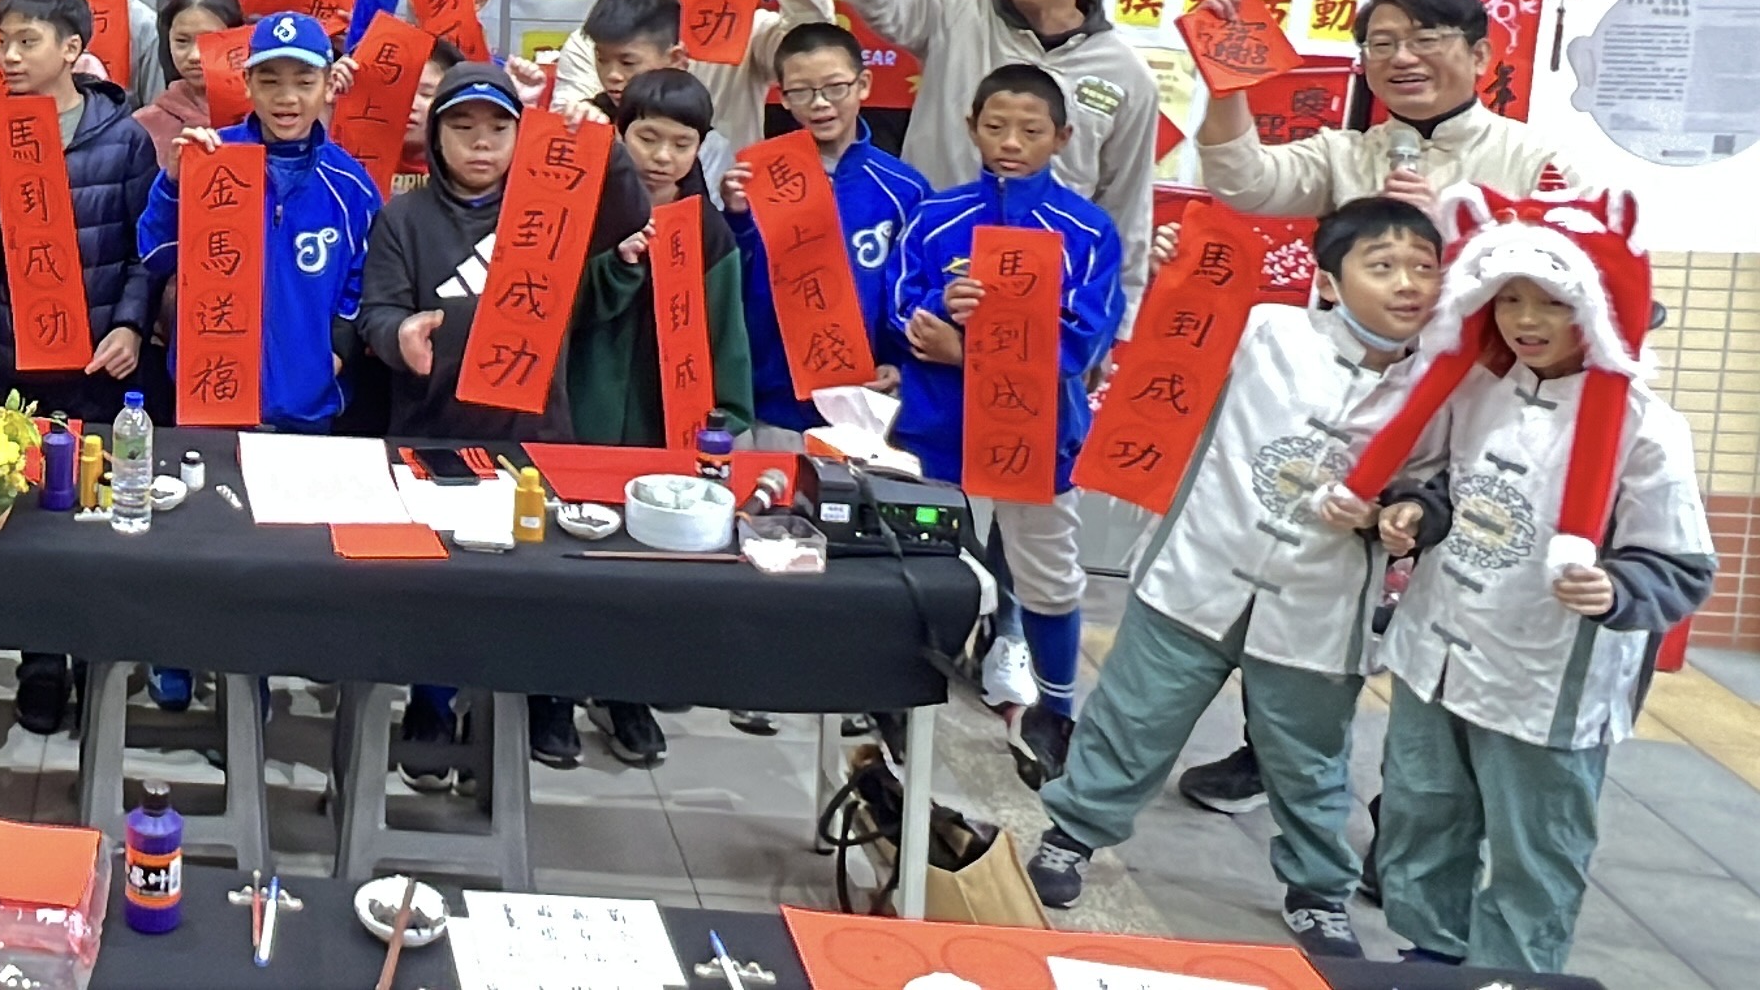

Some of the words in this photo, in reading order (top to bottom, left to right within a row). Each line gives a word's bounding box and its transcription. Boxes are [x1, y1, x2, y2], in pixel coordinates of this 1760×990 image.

[7, 115, 72, 345] 馬到成功
[189, 165, 253, 404] 金馬送福
[477, 136, 590, 388] 馬到成功
[766, 154, 857, 374] 馬上有錢
[984, 249, 1039, 476] 馬到成功
[1106, 241, 1236, 474] 馬到成功
